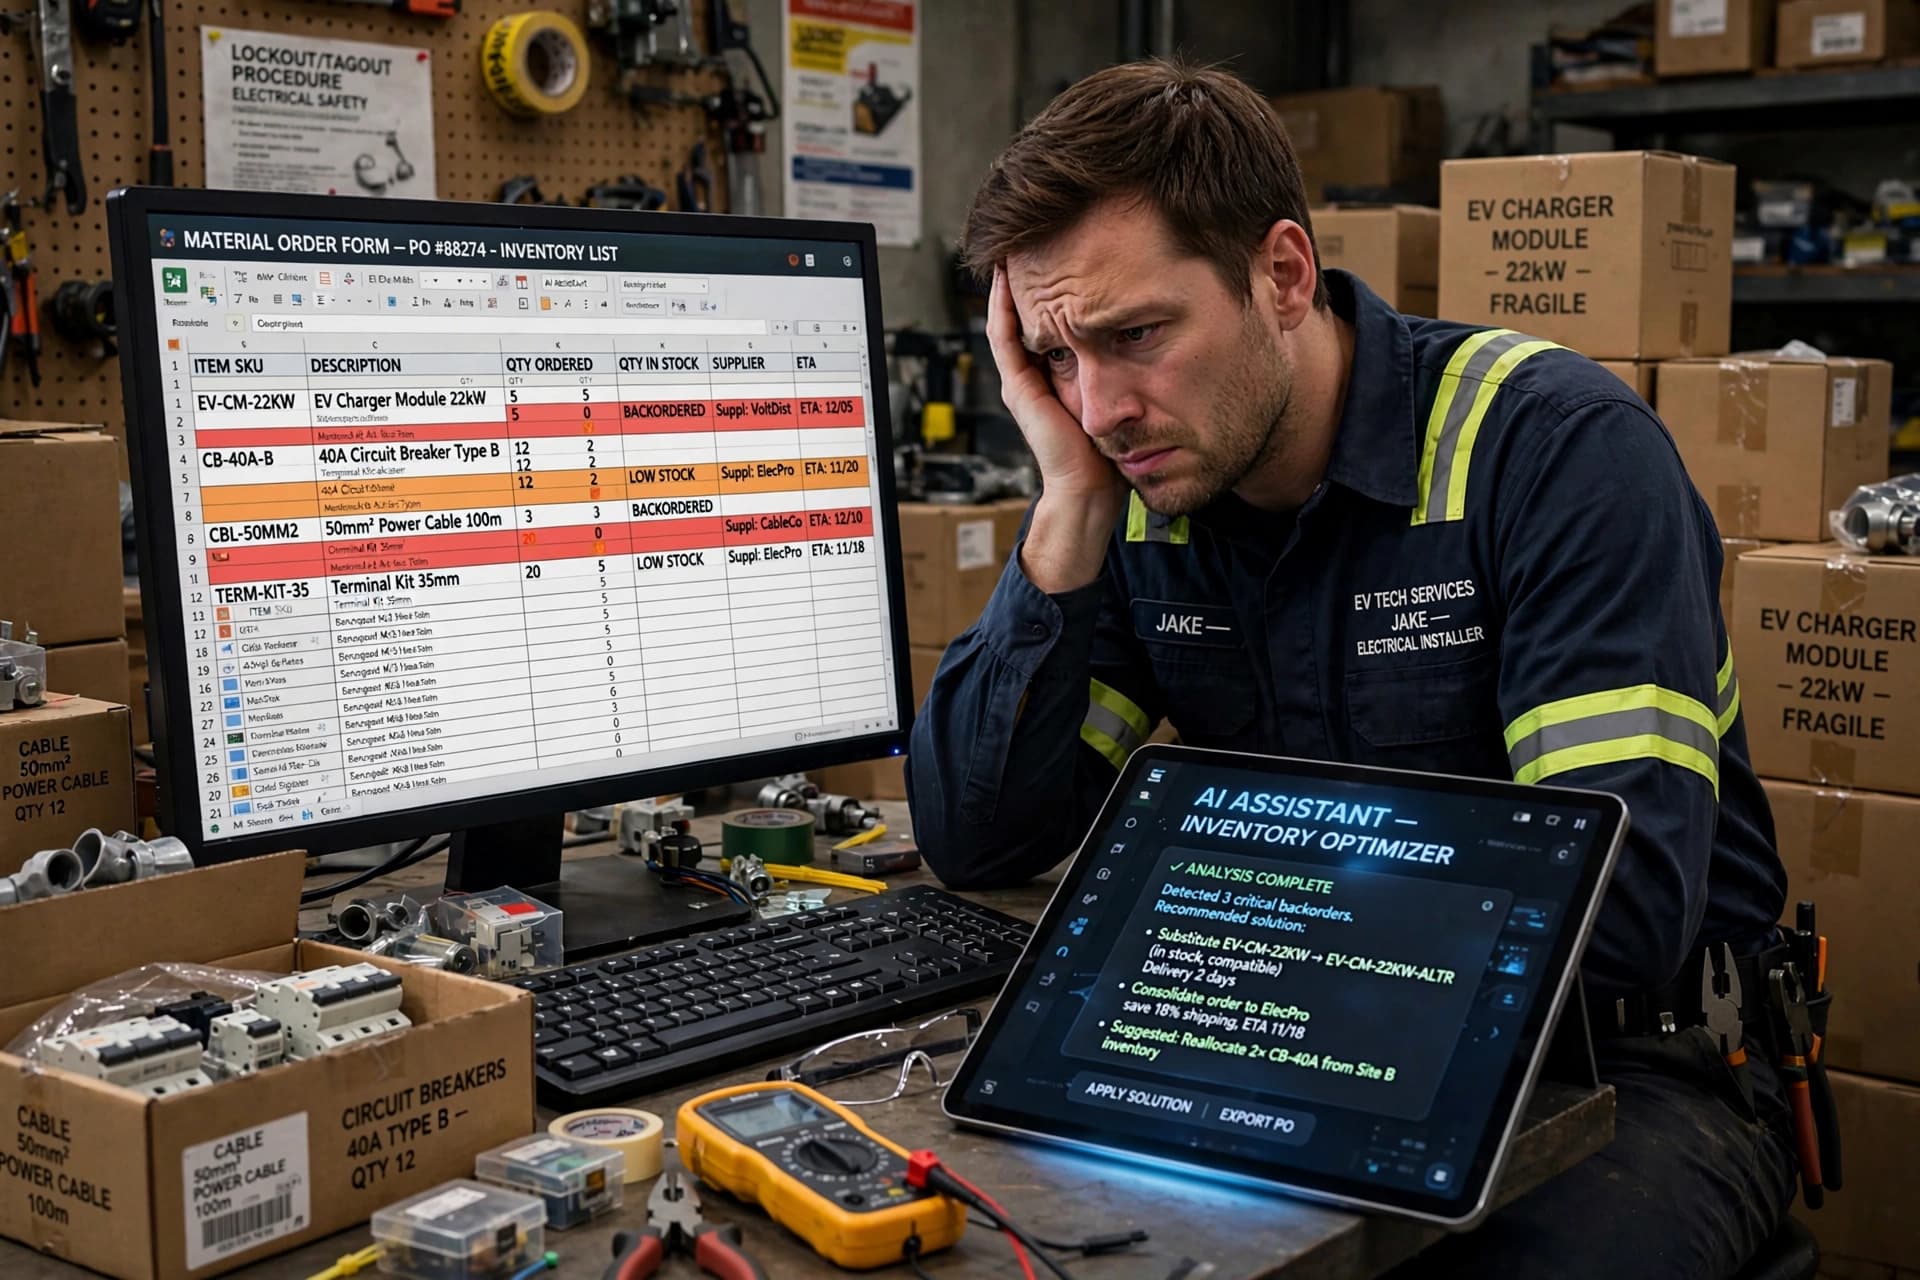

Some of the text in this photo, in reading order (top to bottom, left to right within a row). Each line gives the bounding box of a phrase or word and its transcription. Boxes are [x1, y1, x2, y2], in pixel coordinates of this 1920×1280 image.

[231, 44, 392, 76] LOCKOUT/TAGOUT
[232, 65, 342, 89] PROCEDURE
[233, 87, 368, 109] ELECTRICAL SAFETY
[1468, 196, 1614, 221] EV CHARGER
[184, 230, 618, 261] MATERIAL ORDER FORM PO #88274 INVENTORY LIST
[1492, 228, 1588, 250] MODULE
[1506, 261, 1566, 282] 22kW
[1490, 293, 1587, 314] FRAGILE
[194, 358, 264, 374] ITEM SKU
[311, 358, 401, 372] DESCRIPTION
[506, 357, 593, 372] QTY ORDERED
[620, 357, 699, 371] QTY IN STOCK
[712, 357, 765, 370] SUPPLIER
[797, 356, 816, 370] ETA
[198, 394, 295, 410] EV-CM-22KW
[314, 390, 486, 412] EV Charger Module 22kW
[624, 404, 706, 419] BACKORDERED
[716, 401, 792, 417] Suppl: VoltDist
[800, 400, 853, 414] ETA: 12/05
[203, 452, 274, 467] CB-40A-B
[319, 443, 500, 464] 40A Circuit Breaker Type B
[515, 442, 529, 456] 12
[517, 459, 531, 472] 12
[630, 467, 695, 484] LOW STOCK
[721, 464, 794, 481] Suppl: ElecPro
[805, 461, 858, 475] ETA: 11/20
[519, 476, 533, 489] 12
[632, 500, 713, 518] BACKORDERED
[809, 512, 863, 528] ETA: 12/10
[209, 523, 299, 542] CBL-50MM2
[379, 516, 422, 533] Power
[426, 514, 462, 530] Cable
[466, 512, 502, 528] 100m
[726, 516, 802, 534] Suppl: CableCo
[728, 546, 802, 564] Suppl: ElecPro
[812, 540, 864, 557] ETA: 11/18
[637, 552, 704, 570] LOW STOCK
[331, 572, 460, 594] Terminal Kit 35mm
[526, 566, 541, 580] 20
[215, 582, 310, 604] TERM-KIT-35
[1354, 579, 1476, 610] EV TECH SERVICES
[1761, 608, 1916, 642] EV CHARGER
[1357, 625, 1485, 656] ELECTRICAL INSTALLER
[1786, 643, 1888, 672] MODULE
[1800, 677, 1864, 703] 22kW
[1783, 708, 1885, 739] FRAGILE
[20, 736, 70, 757] CABLE
[3, 771, 109, 800] POWER CABLE
[16, 800, 64, 821] QTY 12
[1194, 786, 1391, 827] AI ASSISTANT
[1180, 814, 1455, 866] INVENTORY OPTIMIZER
[1185, 862, 1334, 895] ANALYSIS COMPLETE
[1161, 883, 1353, 922] Detected 3 critical backorders.
[1155, 900, 1306, 933] Recommended solution:
[1149, 943, 1282, 978] (in stock, compatible)
[1156, 926, 1455, 984] Substitute EV-CM-22KW EV-CM-22KW-ALTR
[1142, 960, 1236, 988] Delivery 2 days
[1131, 980, 1310, 1023] Consolidate order to ElecPro
[1123, 999, 1306, 1040] save 18% shipping, ETA 11/18
[1101, 1036, 1160, 1061] inventory
[1110, 1018, 1180, 1047] Suggested:
[1181, 1032, 1248, 1057] Reallocate
[1268, 1047, 1319, 1070] CB-40A
[1320, 1053, 1354, 1074] from
[1356, 1061, 1381, 1077] Site
[1384, 1067, 1396, 1081] B
[342, 1058, 507, 1131] CIRCUIT BREAKERS
[1085, 1081, 1193, 1114] APPLY SOLUTION
[17, 1107, 71, 1143] CABLE
[1220, 1108, 1294, 1133] EXPORT PO
[348, 1107, 449, 1160] 40A TYPE B
[214, 1131, 263, 1160] CABLE
[194, 1176, 243, 1201] POWER
[245, 1159, 286, 1184] CABLE
[351, 1151, 415, 1190] QTY 12
[0, 1153, 112, 1211] POWER CABLE
[28, 1194, 69, 1225] 100m
[195, 1196, 232, 1218] 100m
